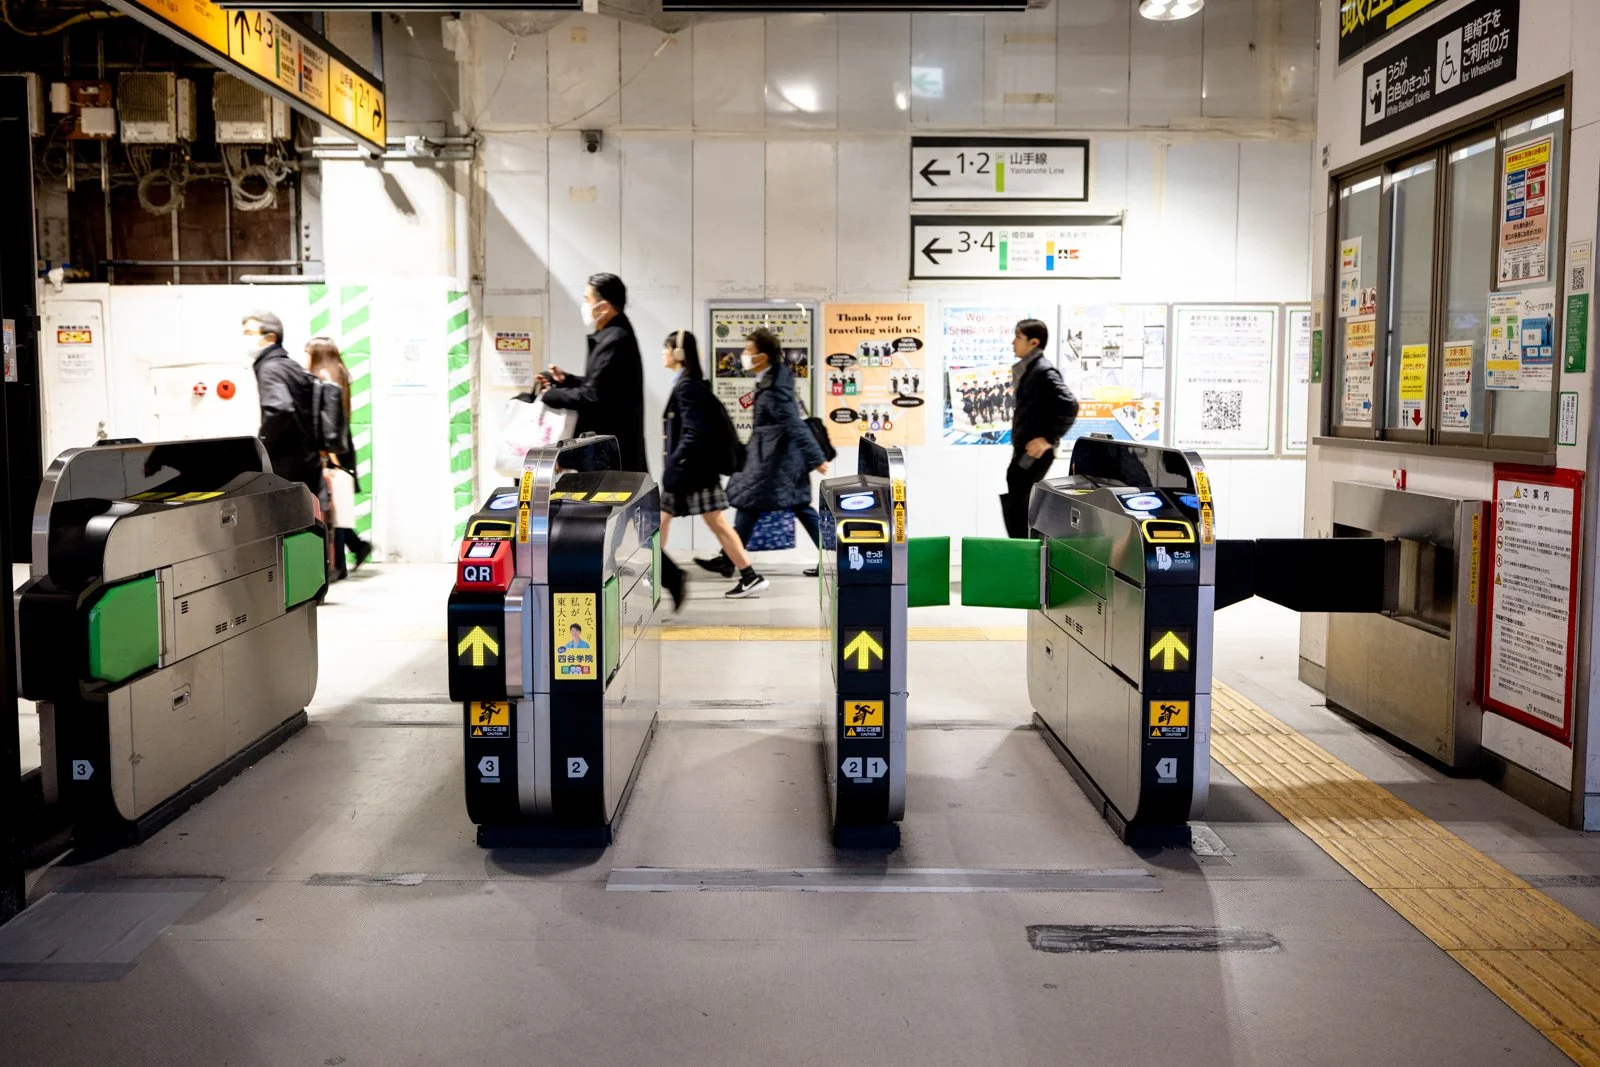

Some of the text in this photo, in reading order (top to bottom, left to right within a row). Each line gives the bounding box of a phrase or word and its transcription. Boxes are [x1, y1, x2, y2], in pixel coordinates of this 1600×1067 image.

[1464, 8, 1501, 43] 車椅子を
[1463, 28, 1510, 66] ご利用の方
[1388, 56, 1408, 82] うらが
[1470, 55, 1503, 78] Wheelchair
[1387, 66, 1431, 104] 白色のきっぷ
[1386, 103, 1398, 117] White
[1414, 90, 1431, 104] Tickets
[1010, 152, 1047, 165] 山手線
[1010, 166, 1064, 175] Yamanote Line
[837, 313, 912, 324] Thank you for
[829, 326, 921, 336] traveling with us!
[1522, 488, 1550, 502] ご案内
[865, 551, 884, 559] きっぷ
[1173, 550, 1191, 559] きっぷ
[464, 566, 490, 581] QR
[571, 597, 580, 616] 私が
[557, 655, 594, 663] 四谷学院
[77, 763, 86, 775] 3
[485, 760, 495, 772] 3
[571, 762, 581, 774] 2
[849, 761, 858, 773] 2
[871, 761, 878, 774] 1
[1164, 762, 1171, 774] 1
